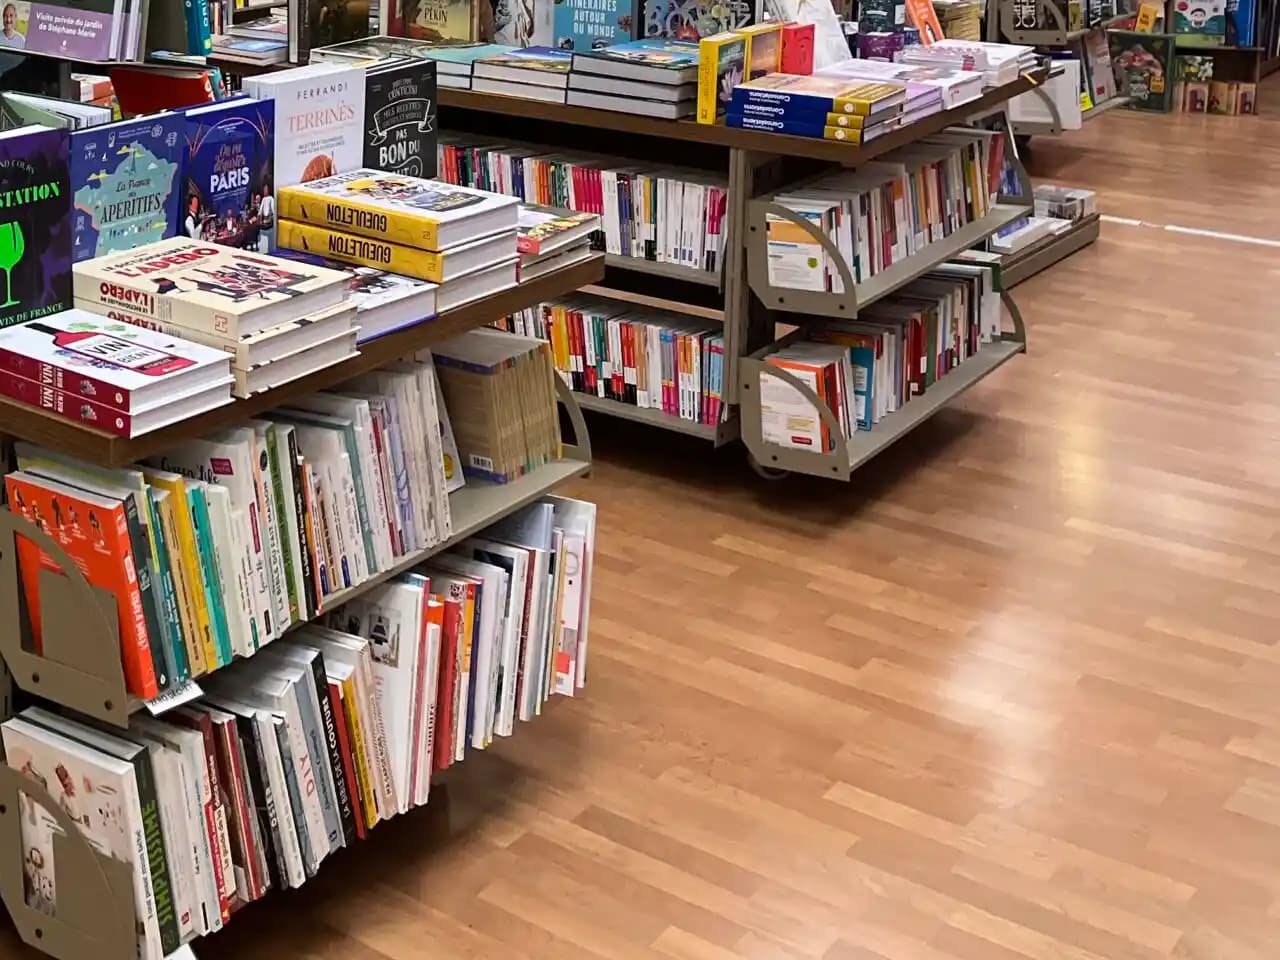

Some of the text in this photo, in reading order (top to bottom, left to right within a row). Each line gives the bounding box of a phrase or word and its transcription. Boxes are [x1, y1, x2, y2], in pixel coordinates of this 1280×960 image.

[36, 12, 103, 30] Visite privée du jardin
[573, 9, 605, 23] AUTOUR
[1089, 1, 1101, 27] Van
[38, 24, 47, 32] de
[573, 24, 616, 39] DU MONDE
[296, 82, 348, 100] FERRANDI
[395, 128, 408, 140] PAS
[379, 140, 421, 167] BON DU
[115, 182, 126, 192] La
[210, 167, 250, 193] PARIS
[326, 203, 388, 233] GUEULETON
[328, 235, 392, 264] GUEULETON
[16, 311, 29, 322] DE
[30, 302, 64, 319] FRANCE
[86, 339, 130, 356] VIN
[43, 364, 54, 386] VIN
[43, 387, 54, 409] VIN
[322, 695, 337, 750] COUTURE
[299, 754, 315, 798] DIY
[142, 799, 174, 925] SIMPLISSIME
